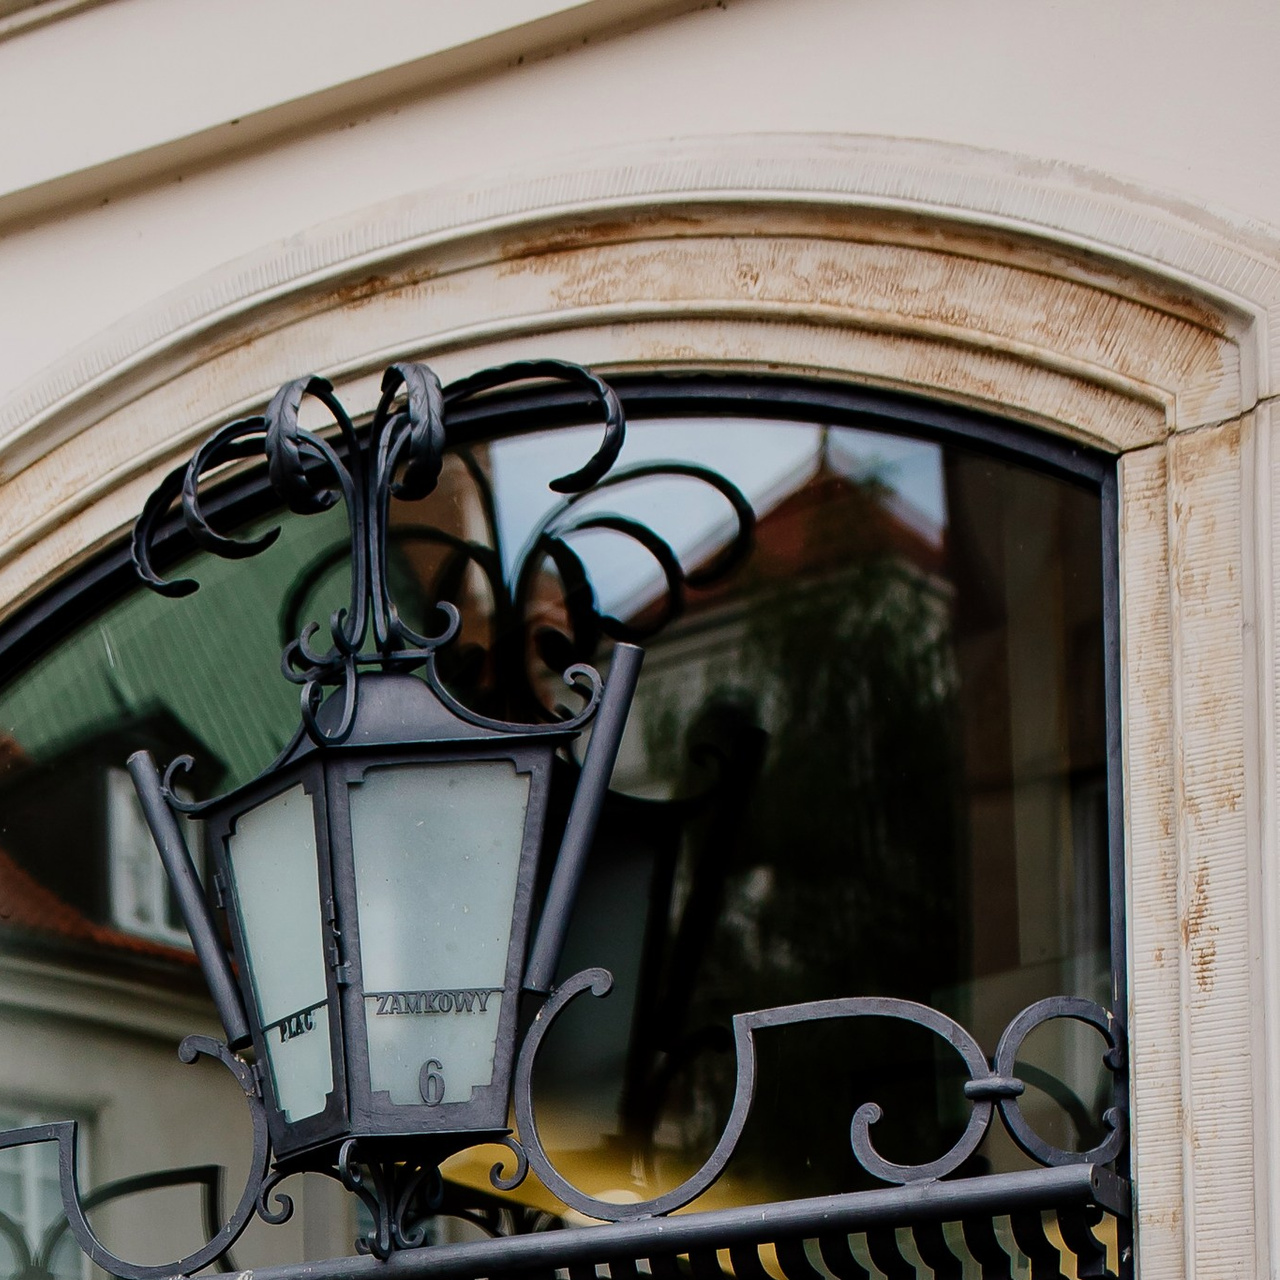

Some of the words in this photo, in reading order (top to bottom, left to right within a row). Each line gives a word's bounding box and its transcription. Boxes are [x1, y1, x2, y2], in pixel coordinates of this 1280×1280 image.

[375, 990, 490, 1015] ZAMKOWY
[280, 1010, 313, 1043] PLAC
[419, 1058, 445, 1107] 6
